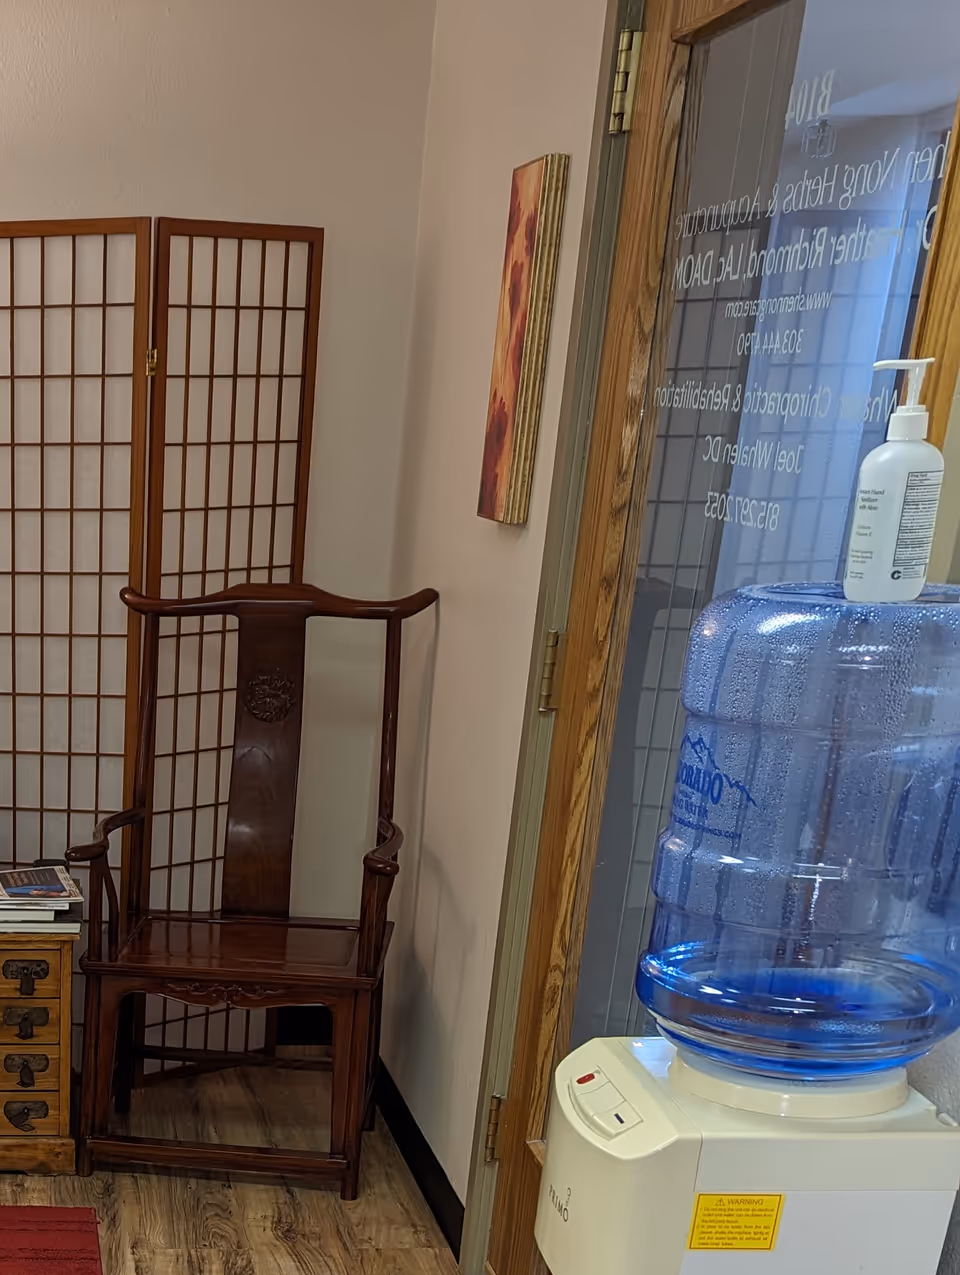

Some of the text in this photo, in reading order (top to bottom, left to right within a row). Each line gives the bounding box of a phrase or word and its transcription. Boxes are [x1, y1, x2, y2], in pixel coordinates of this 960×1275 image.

[677, 761, 724, 805] ORADO
[549, 1184, 569, 1222] PRIMO
[727, 1198, 764, 1206] WARNING
